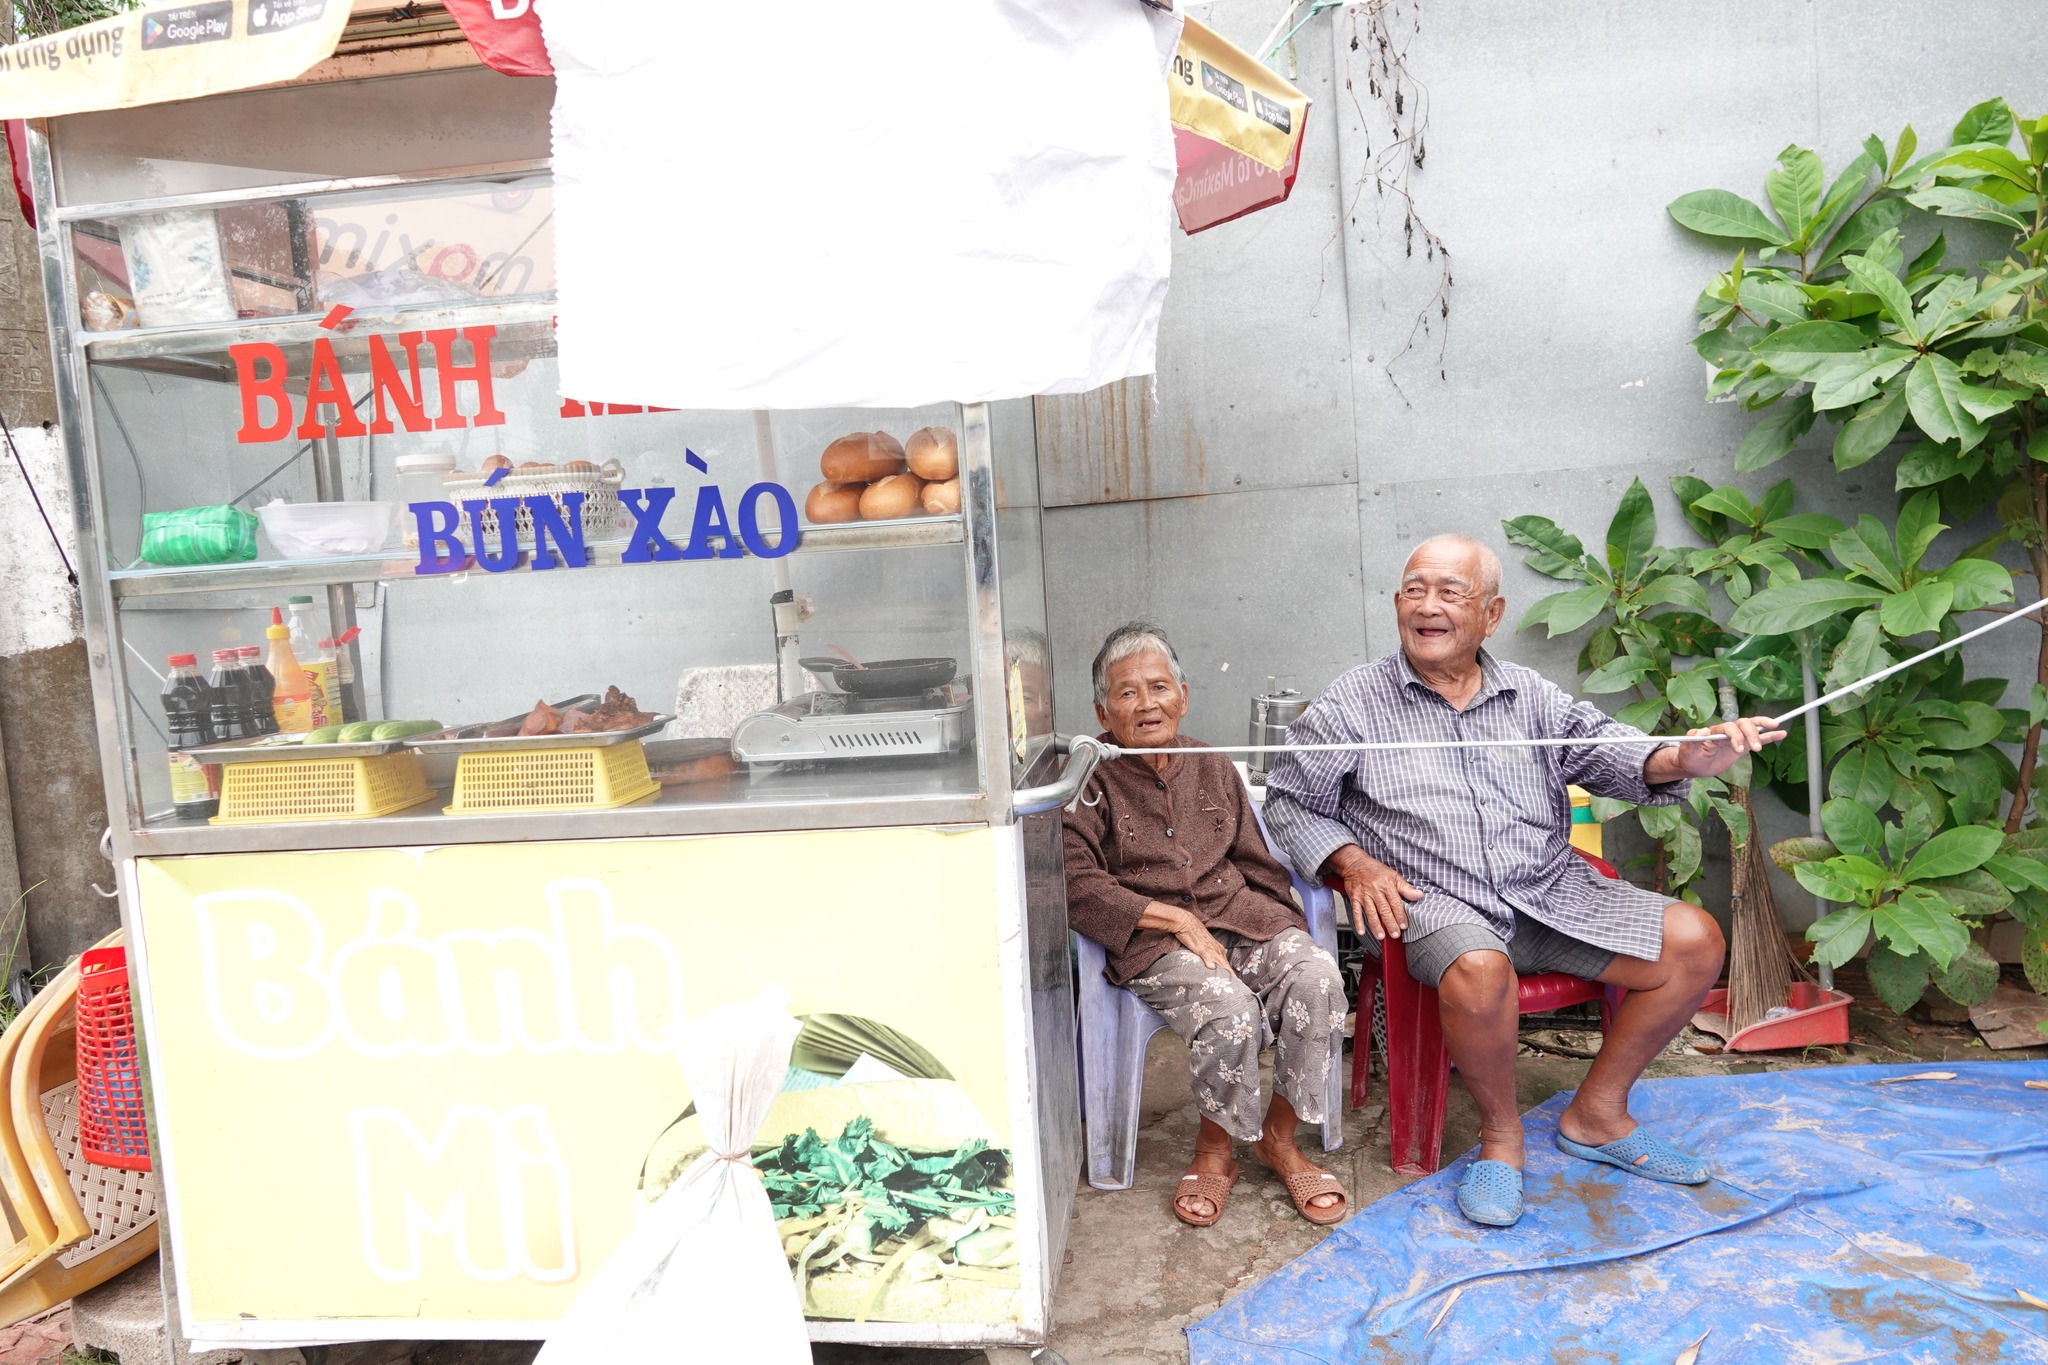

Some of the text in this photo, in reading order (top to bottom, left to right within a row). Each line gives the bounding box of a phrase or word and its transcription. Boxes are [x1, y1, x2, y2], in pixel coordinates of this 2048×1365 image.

[167, 18, 228, 40] Google Play
[270, 4, 323, 27] App Store
[66, 27, 124, 64] dụng
[1170, 55, 1194, 86] ng
[1215, 81, 1233, 101] Google
[1232, 90, 1245, 108] Play
[1264, 107, 1277, 123] App
[229, 304, 506, 443] BÁNH
[408, 447, 801, 575] BÚN XÀO
